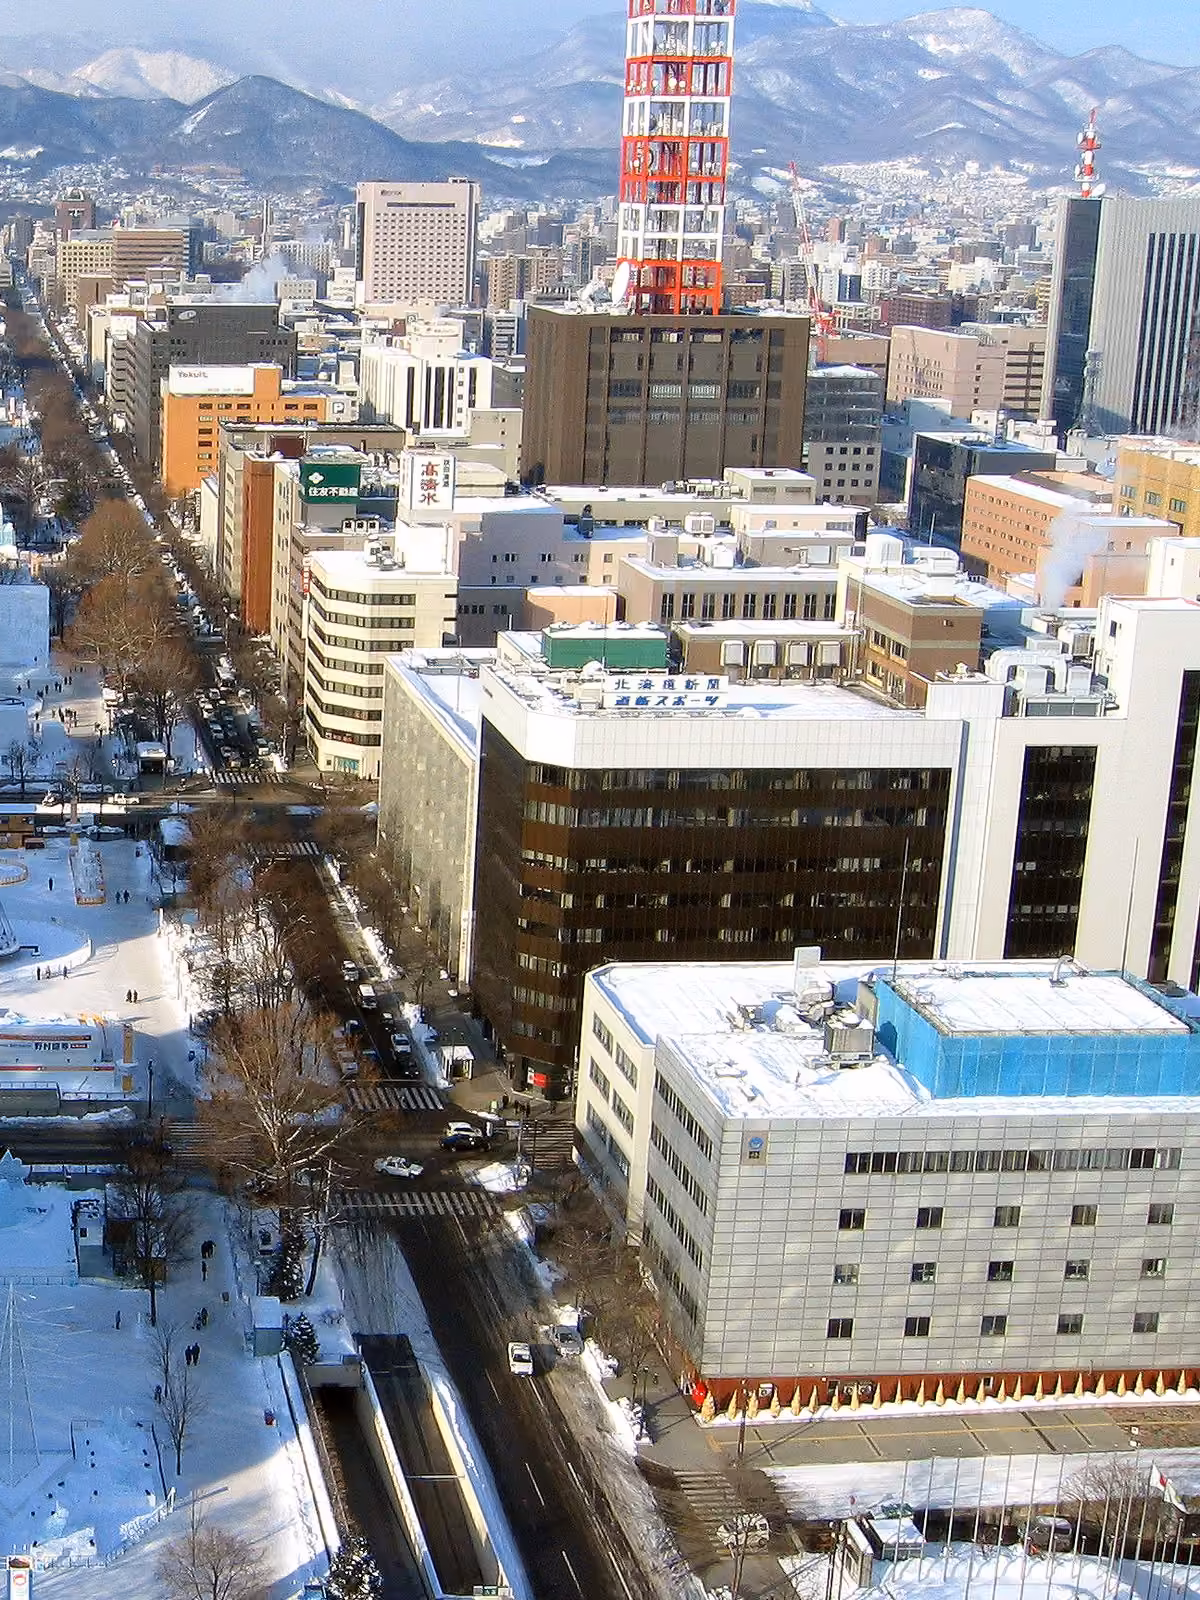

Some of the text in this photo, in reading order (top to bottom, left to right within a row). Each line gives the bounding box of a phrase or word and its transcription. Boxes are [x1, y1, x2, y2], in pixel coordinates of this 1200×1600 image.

[614, 678, 720, 691] 北海道新聞
